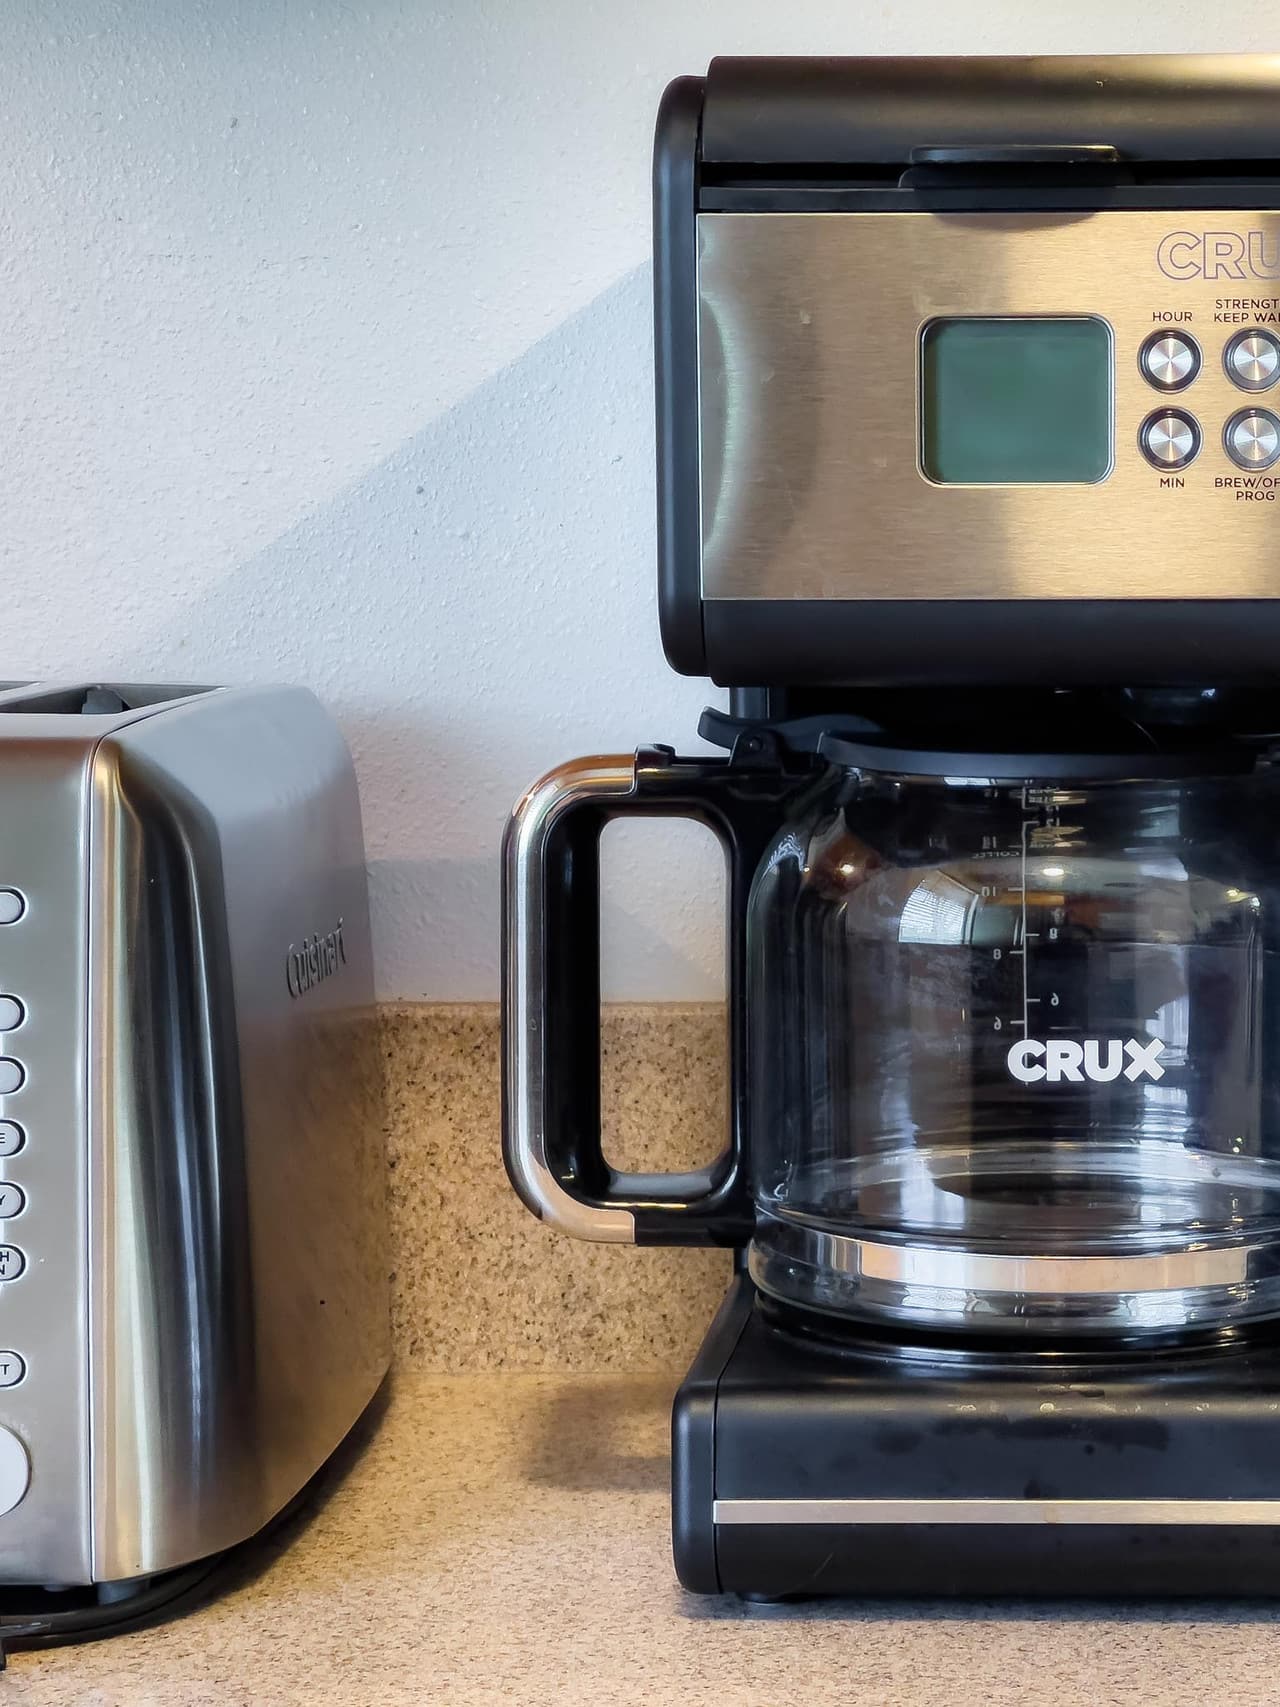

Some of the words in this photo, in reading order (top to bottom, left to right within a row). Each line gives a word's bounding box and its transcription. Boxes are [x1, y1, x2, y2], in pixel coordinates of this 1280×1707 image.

[1152, 311, 1193, 322] HOUR
[1213, 312, 1249, 323] KEEP
[1159, 477, 1185, 488] MIN
[1235, 490, 1276, 502] PROG
[1007, 1038, 1166, 1082] CRUX
